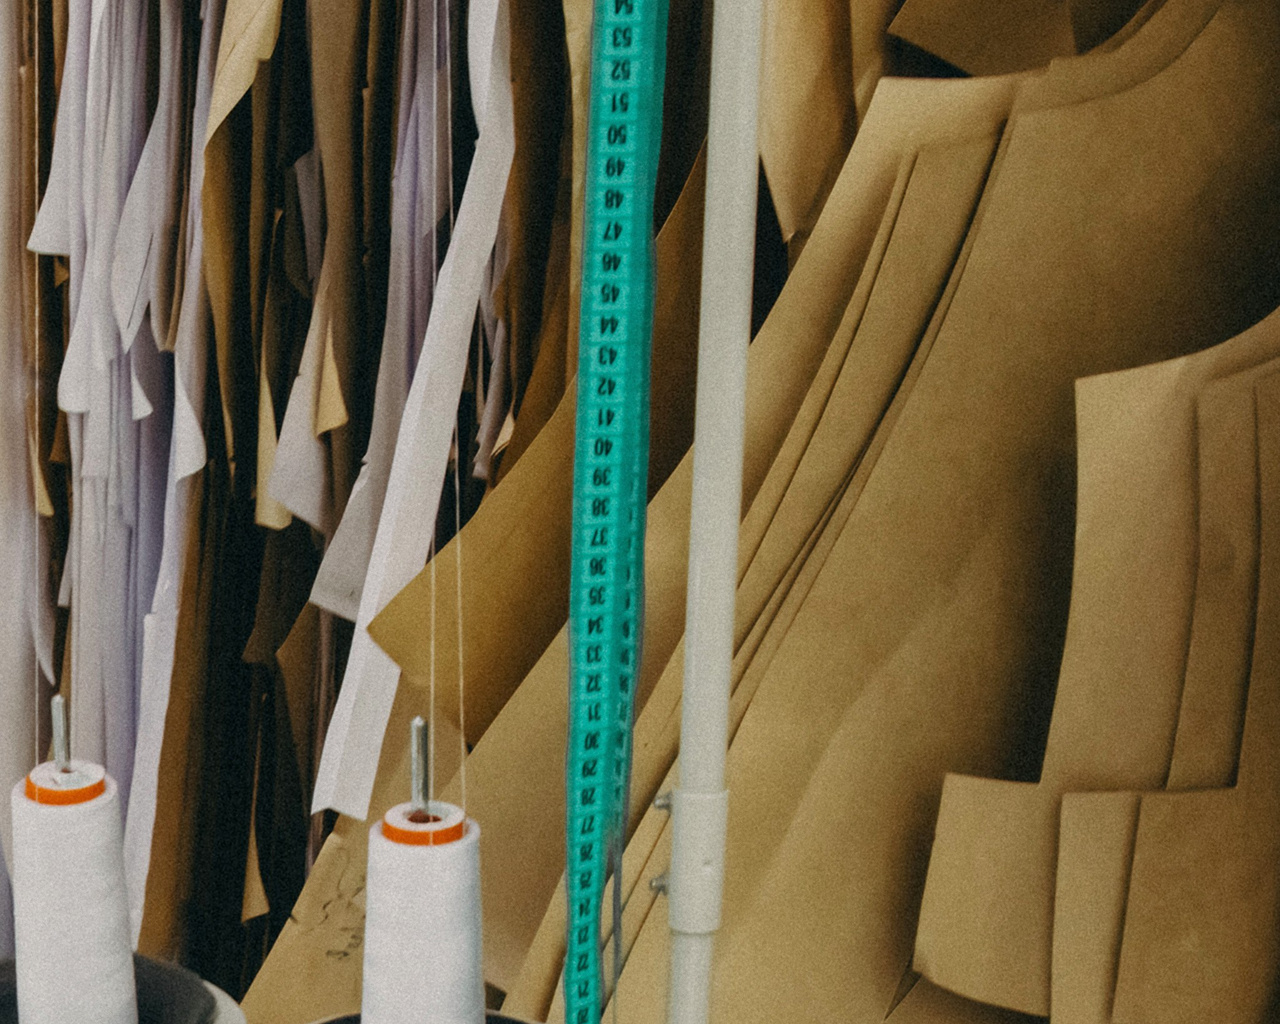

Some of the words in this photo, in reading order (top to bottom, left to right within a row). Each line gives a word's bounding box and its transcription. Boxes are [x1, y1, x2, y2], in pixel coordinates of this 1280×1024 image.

[612, 27, 632, 48] 53
[611, 60, 631, 81] 52
[611, 91, 629, 113] 51
[607, 124, 627, 144] 50
[606, 156, 625, 177] 49
[605, 189, 624, 210] 48
[603, 221, 623, 240] 47
[602, 252, 621, 272] 46
[601, 283, 620, 303] 45
[601, 315, 619, 335] 44
[599, 345, 617, 365] 43
[597, 376, 616, 396] 42
[598, 407, 615, 427] 41
[594, 437, 613, 457] 40
[593, 467, 611, 487] 39
[592, 497, 610, 517] 38
[590, 526, 608, 546] 37
[590, 556, 607, 577] 36
[589, 586, 606, 606] 35
[588, 615, 604, 635] 34
[586, 645, 602, 663] 33
[586, 674, 602, 693] 32
[588, 703, 601, 722] 31
[584, 732, 600, 750] 30
[582, 759, 597, 778] 29
[581, 787, 596, 806] 28
[580, 816, 595, 835] 27
[580, 843, 593, 863] 26
[578, 898, 590, 918] 24
